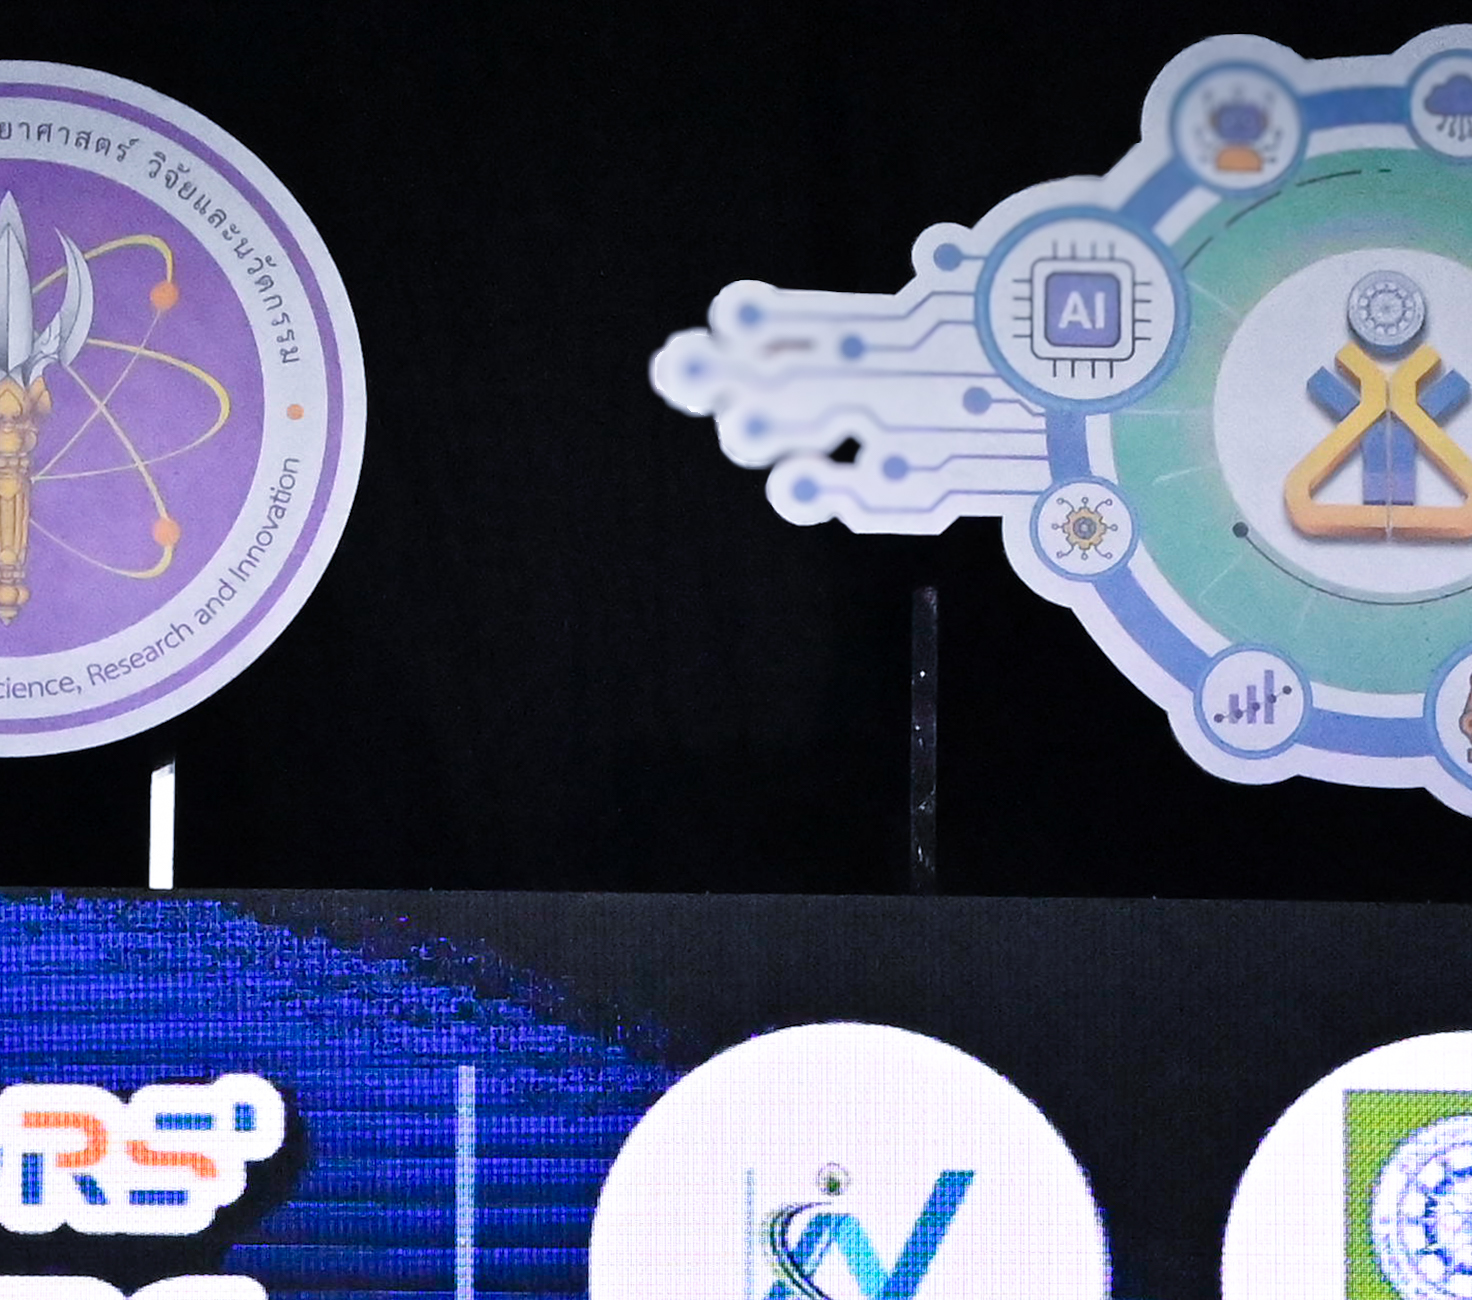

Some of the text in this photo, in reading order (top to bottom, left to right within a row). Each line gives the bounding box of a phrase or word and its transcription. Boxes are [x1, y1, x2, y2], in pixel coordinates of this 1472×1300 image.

[147, 151, 301, 365] วิจัยและนวัตกรรม
[1058, 290, 1105, 329] AI
[88, 621, 193, 687] Research
[193, 578, 236, 625] and
[231, 456, 301, 586] Innovation
